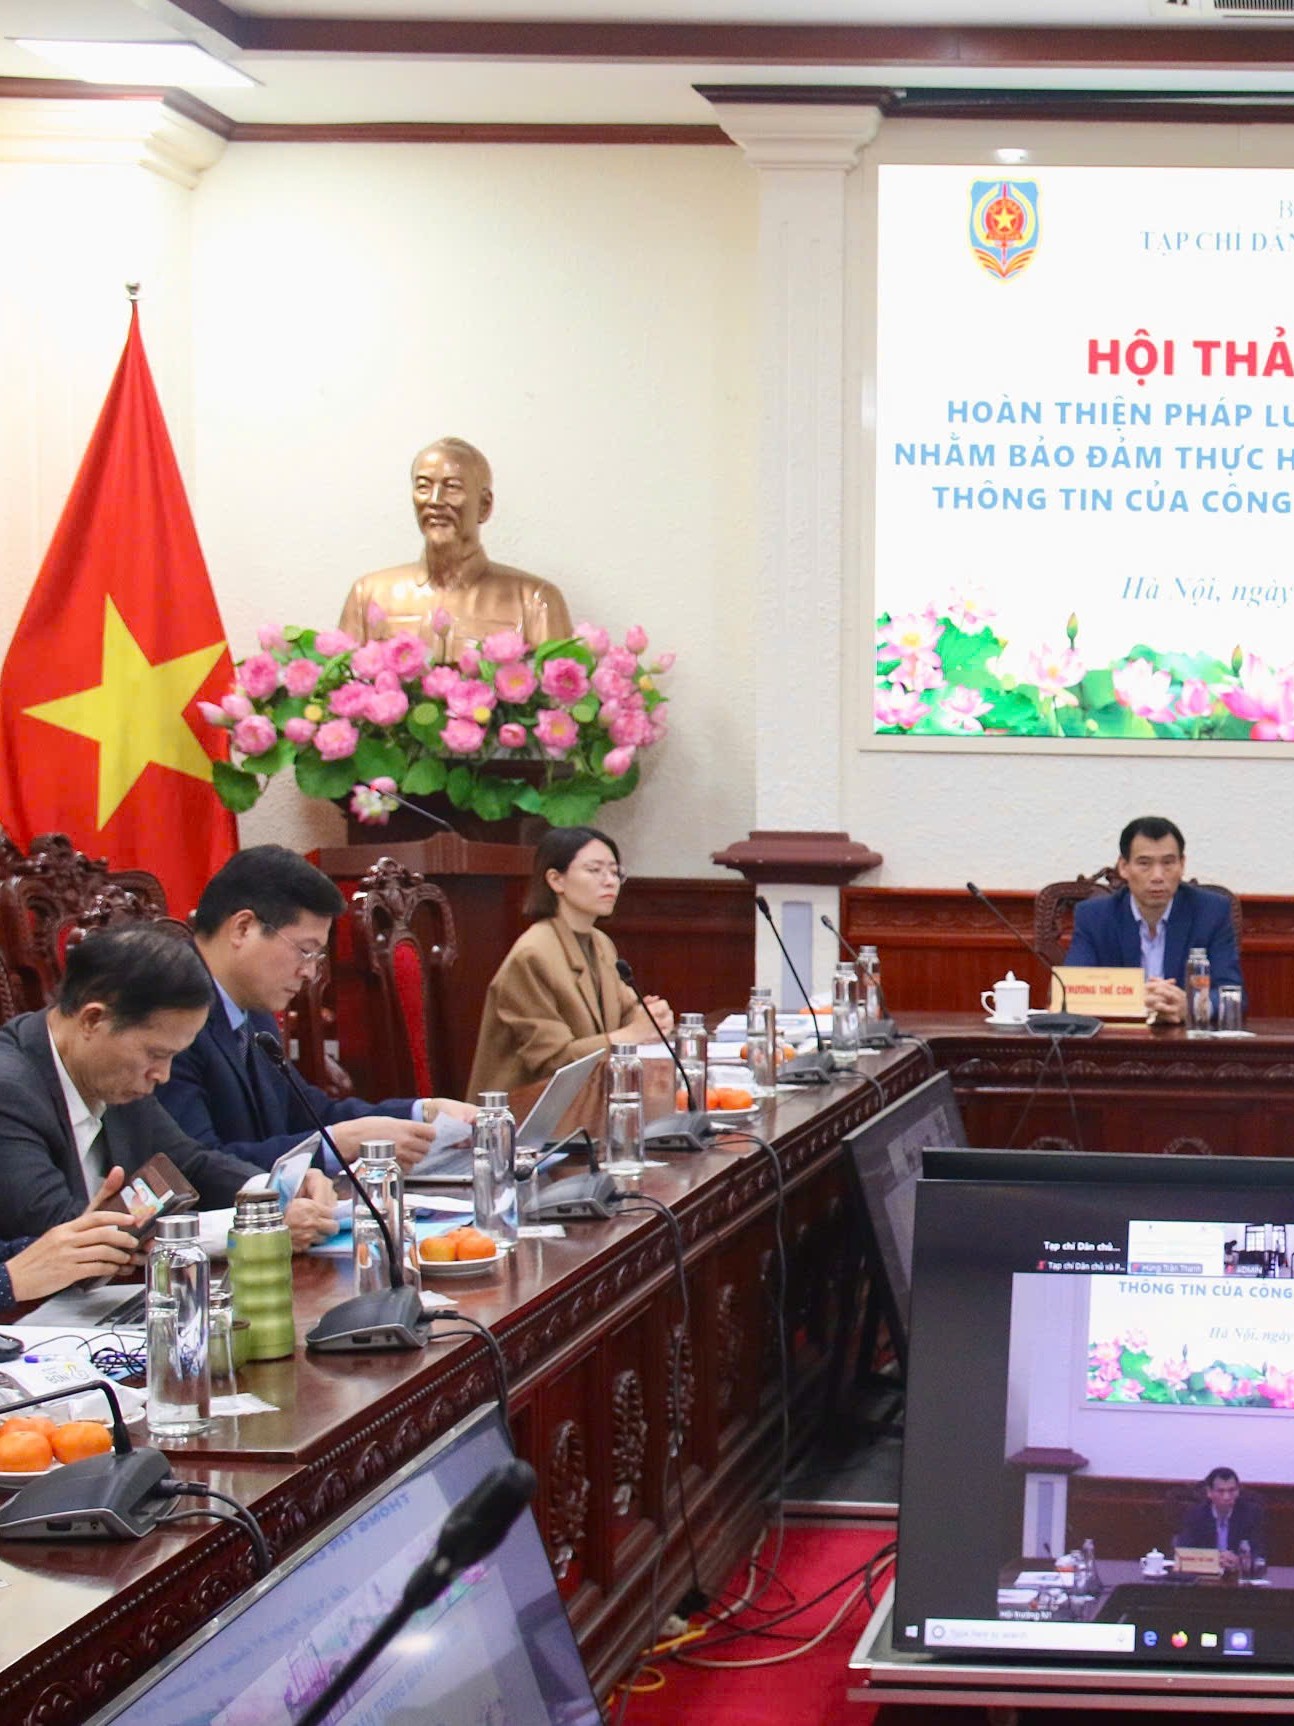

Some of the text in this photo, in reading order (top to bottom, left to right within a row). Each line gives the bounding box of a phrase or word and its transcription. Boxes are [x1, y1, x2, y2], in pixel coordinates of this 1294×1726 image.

[1088, 328, 1174, 386] HỘI
[947, 394, 1042, 424] HOÀN
[1055, 395, 1151, 431] THIỆN
[1165, 397, 1253, 427] PHÁP
[894, 432, 996, 467] NHẰM
[1009, 436, 1074, 467] BẢO
[1086, 436, 1162, 469] ĐẢM
[1175, 444, 1263, 476] THỰC
[932, 480, 1046, 510] THÔNG
[1059, 488, 1113, 511] TIN
[1126, 480, 1189, 512] CỦA
[1202, 483, 1291, 514] CÔNG
[1122, 576, 1160, 600] Hà
[1175, 577, 1221, 606] Nội,
[1232, 578, 1293, 608] ngày
[1119, 1279, 1174, 1295] THÔNG
[1180, 1284, 1207, 1297] TIN
[1212, 1281, 1243, 1298] CỦA
[1249, 1284, 1293, 1299] CÔNG
